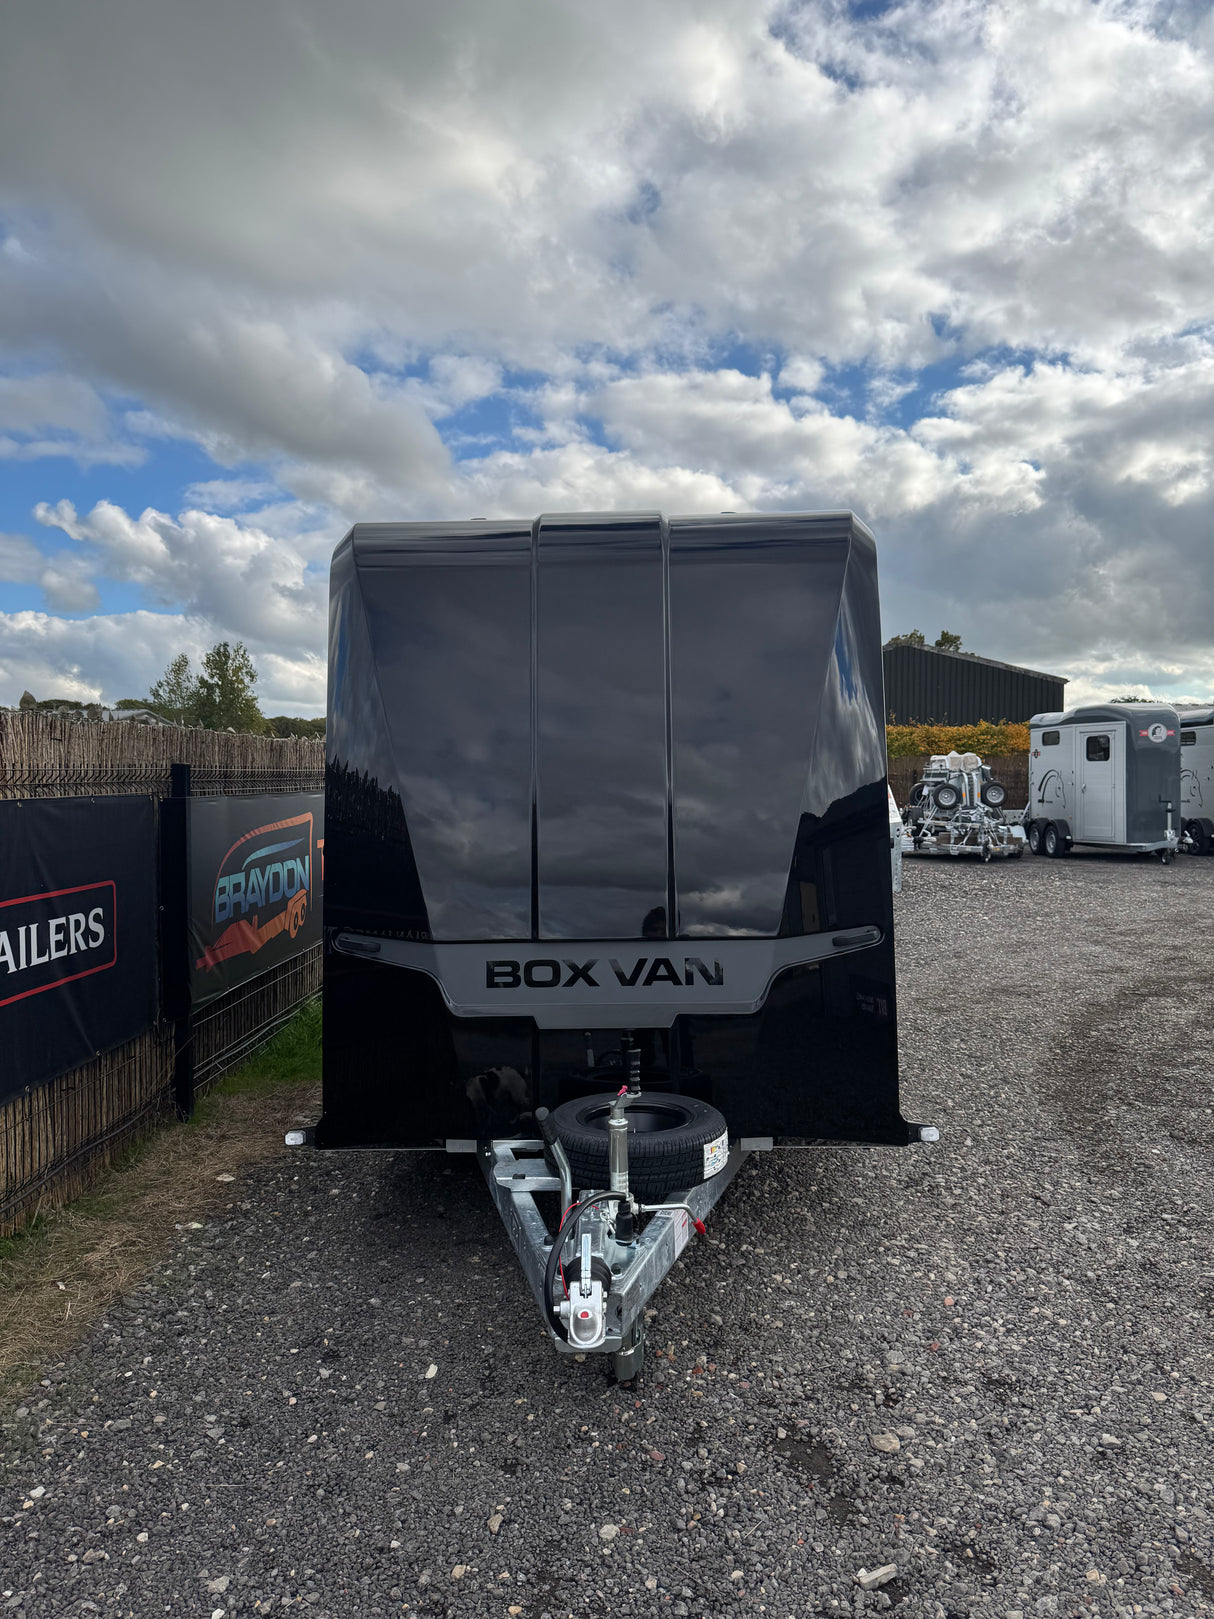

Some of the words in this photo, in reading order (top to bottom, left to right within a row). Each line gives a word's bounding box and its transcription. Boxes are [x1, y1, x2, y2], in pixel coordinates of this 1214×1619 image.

[215, 855, 310, 923] BRAYDON
[486, 959, 600, 988] BOX
[608, 957, 724, 986] VAN
